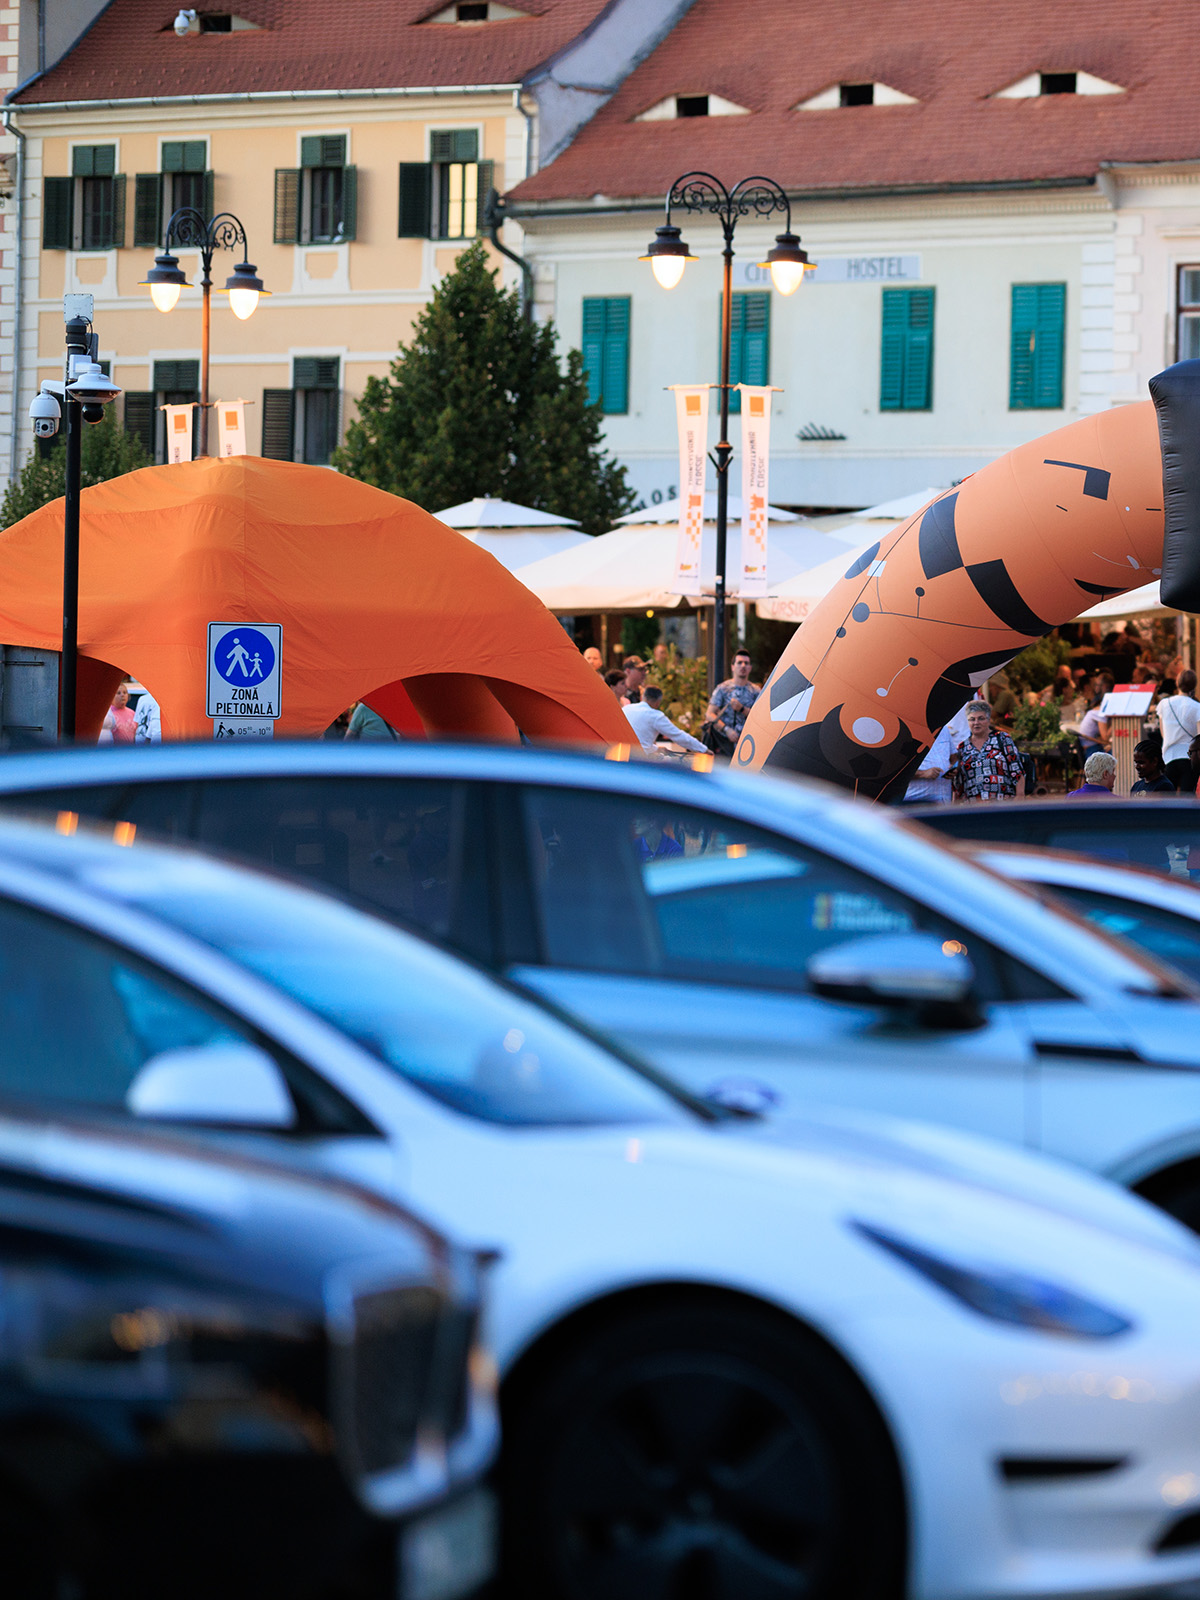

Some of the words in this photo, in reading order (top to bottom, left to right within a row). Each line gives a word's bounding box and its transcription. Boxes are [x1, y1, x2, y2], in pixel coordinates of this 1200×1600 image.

[847, 255, 907, 278] HOSTEL
[231, 687, 259, 700] ZONĂ
[216, 701, 273, 715] PIETONALĂ
